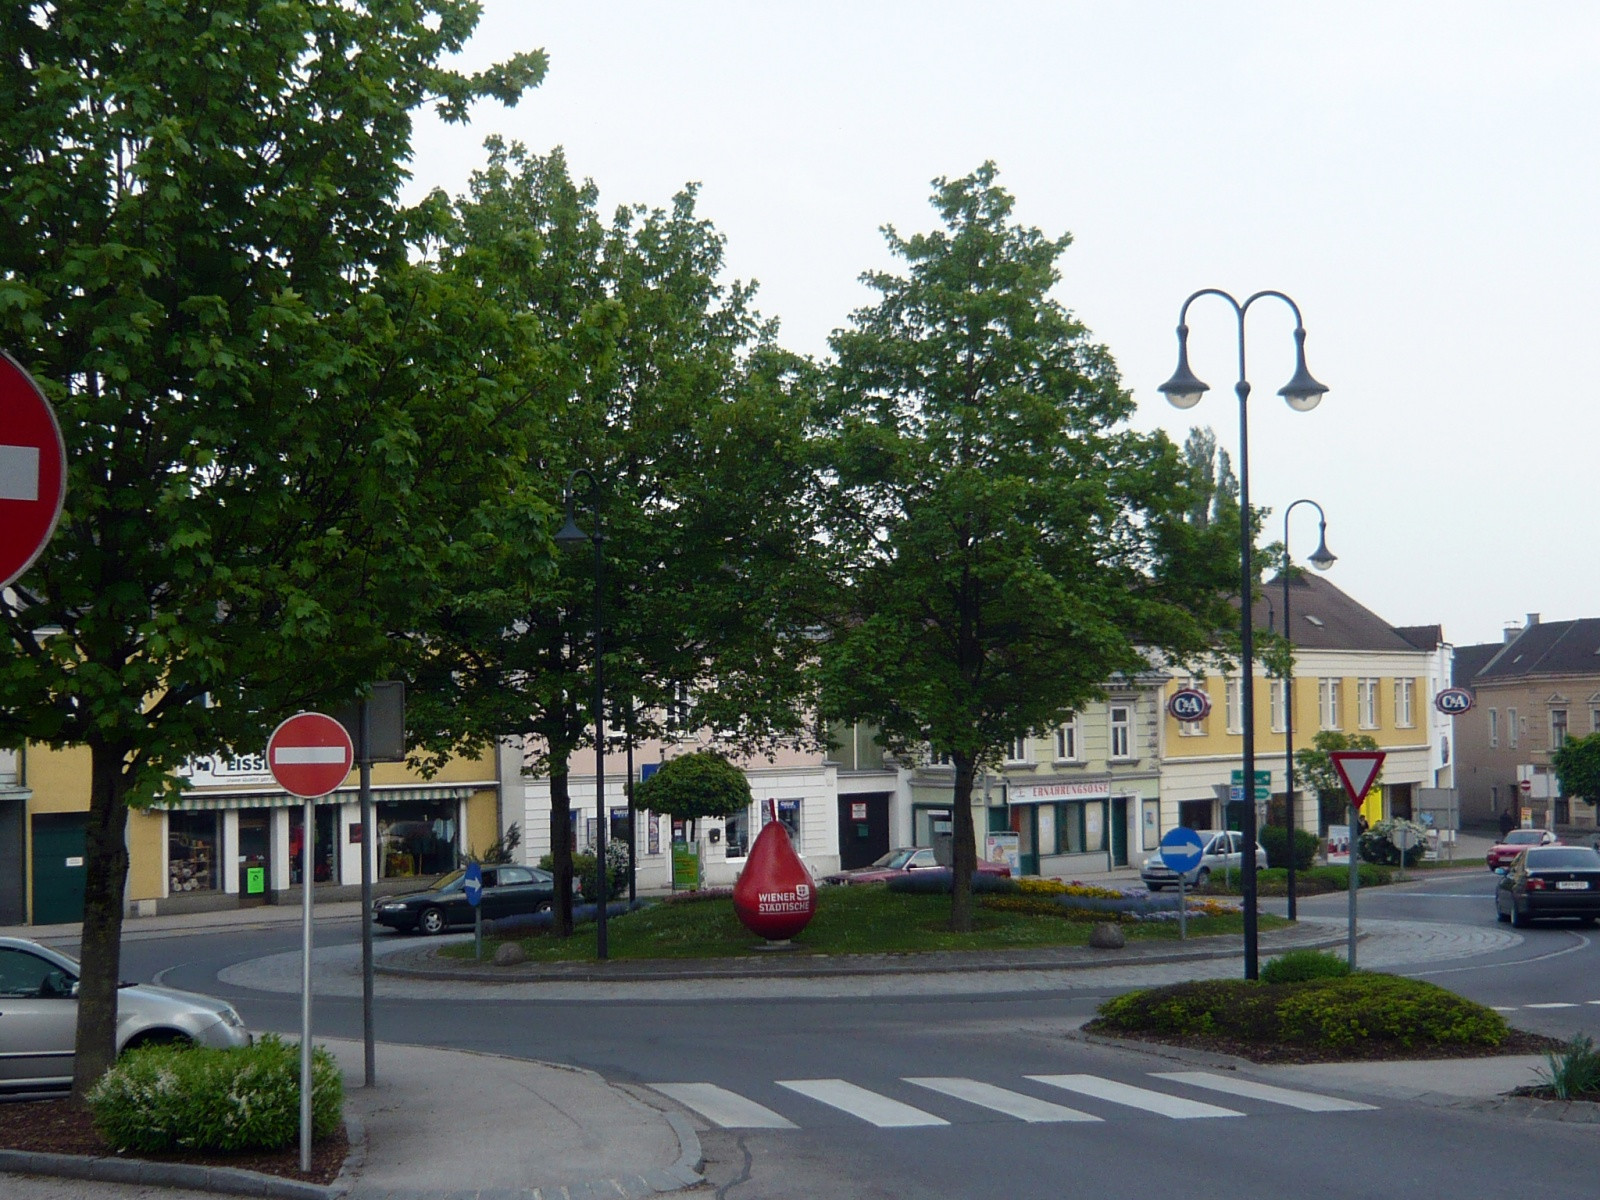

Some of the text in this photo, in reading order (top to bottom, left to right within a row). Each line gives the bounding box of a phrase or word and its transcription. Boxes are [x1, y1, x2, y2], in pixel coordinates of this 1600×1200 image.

[1174, 697, 1200, 713] C&A
[1441, 695, 1466, 708] C&A
[227, 758, 269, 771] EISS
[758, 892, 796, 903] WIENER
